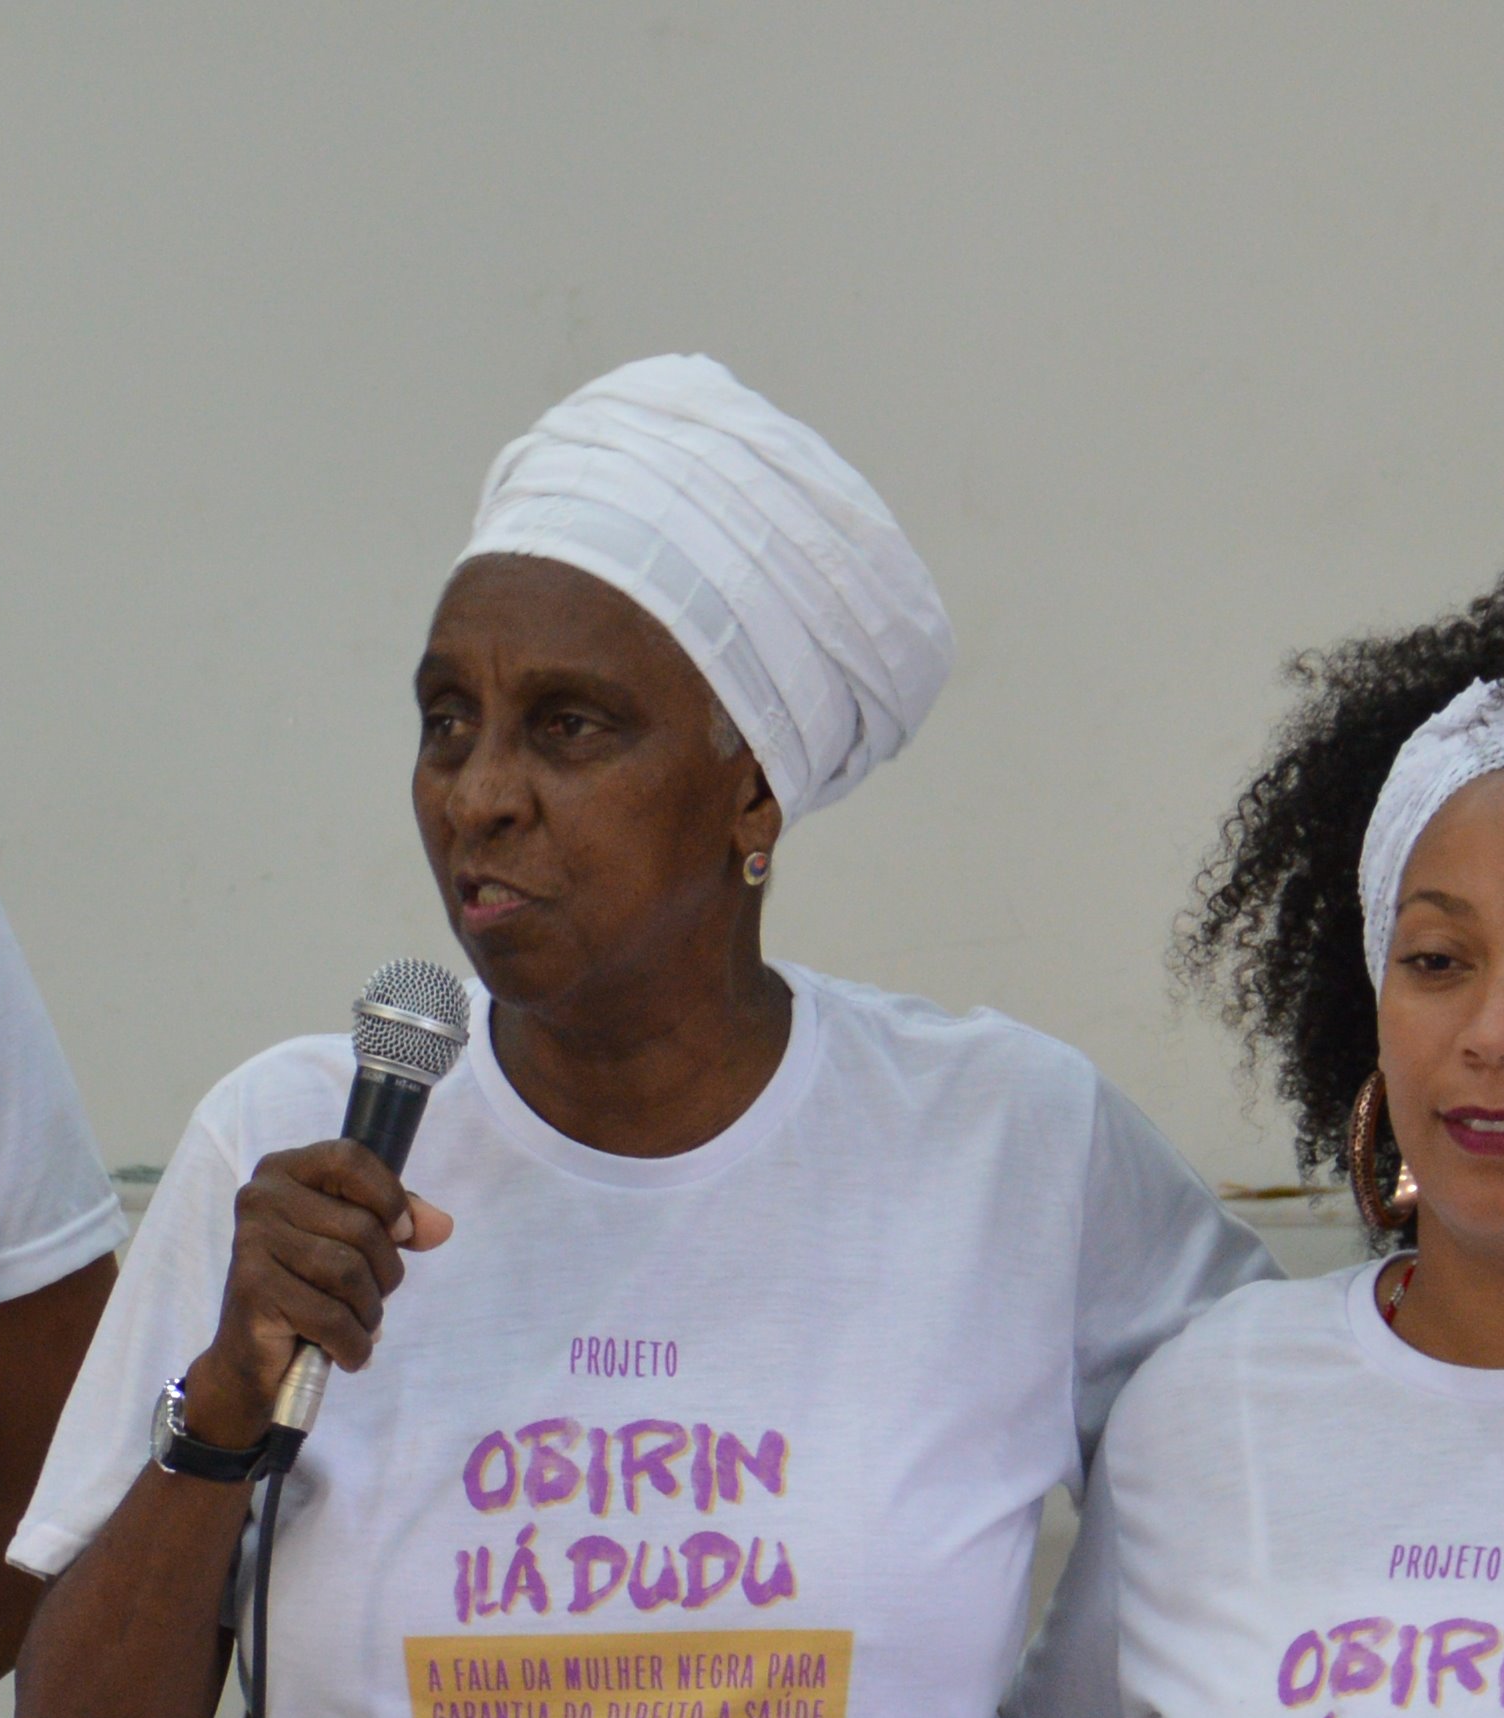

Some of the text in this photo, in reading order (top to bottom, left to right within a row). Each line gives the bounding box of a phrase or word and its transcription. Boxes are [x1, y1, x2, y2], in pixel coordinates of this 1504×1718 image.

[569, 1336, 678, 1378] PROJETO
[462, 1416, 789, 1516] OBIRIN
[454, 1522, 797, 1624] ILÁ DUDU
[1389, 1543, 1502, 1581] PROJETO
[428, 1653, 827, 1692] A FALA DA MULHER NEGRA PARA
